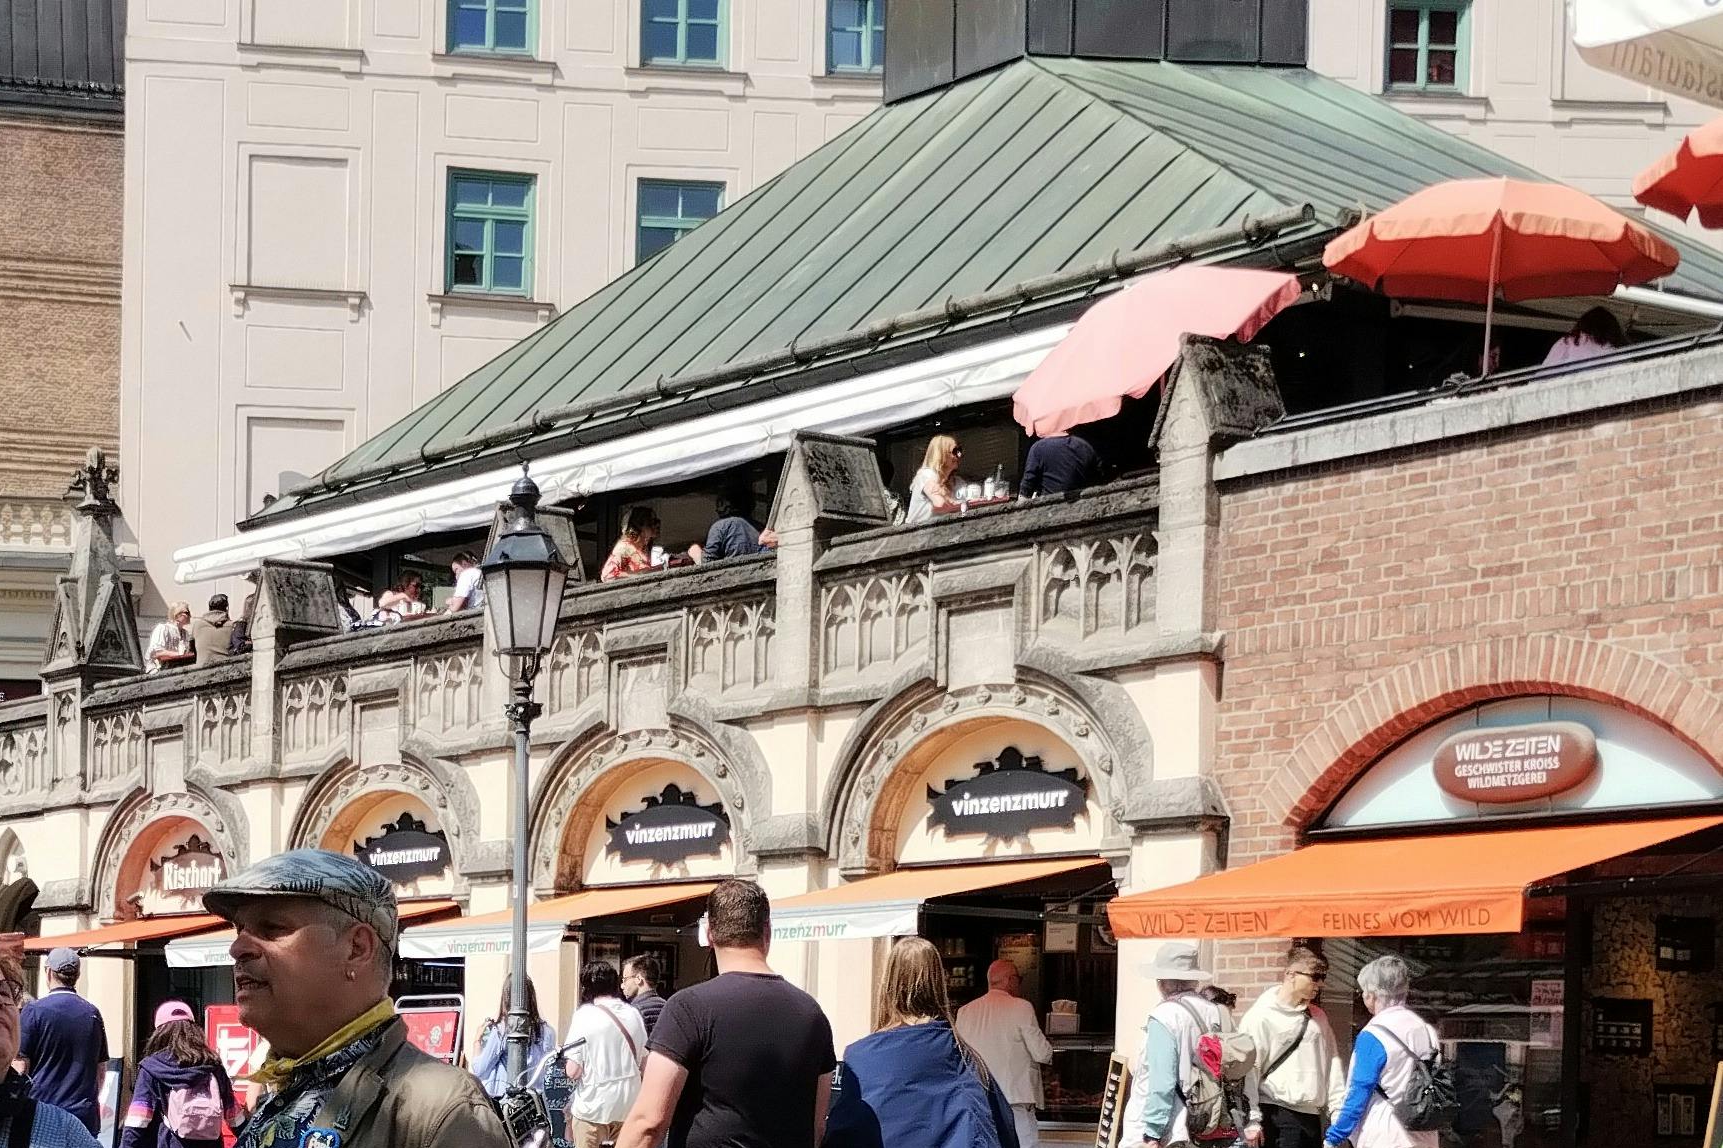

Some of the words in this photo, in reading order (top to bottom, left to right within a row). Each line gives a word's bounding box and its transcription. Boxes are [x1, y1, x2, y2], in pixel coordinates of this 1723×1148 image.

[1455, 740, 1503, 761] WILDE
[1505, 734, 1561, 758] ZEITEN
[1454, 760, 1522, 778] GESCHWISTER
[1523, 756, 1561, 772] KROISS
[1467, 771, 1547, 789] WILDMETZGEREI
[951, 789, 1069, 817] vinzenzmurr
[625, 821, 716, 845] vinzenzmurr
[369, 846, 441, 867] vinzenzmurr
[163, 858, 222, 891] Rischart
[773, 922, 847, 939] nzenzmurr
[1138, 911, 1197, 934] WILDE
[1203, 911, 1269, 934] ZEITEN
[1321, 912, 1381, 931] FEINES
[1388, 910, 1432, 929] VOM
[1441, 907, 1491, 927] WILD
[446, 938, 512, 954] vinzenzmurr
